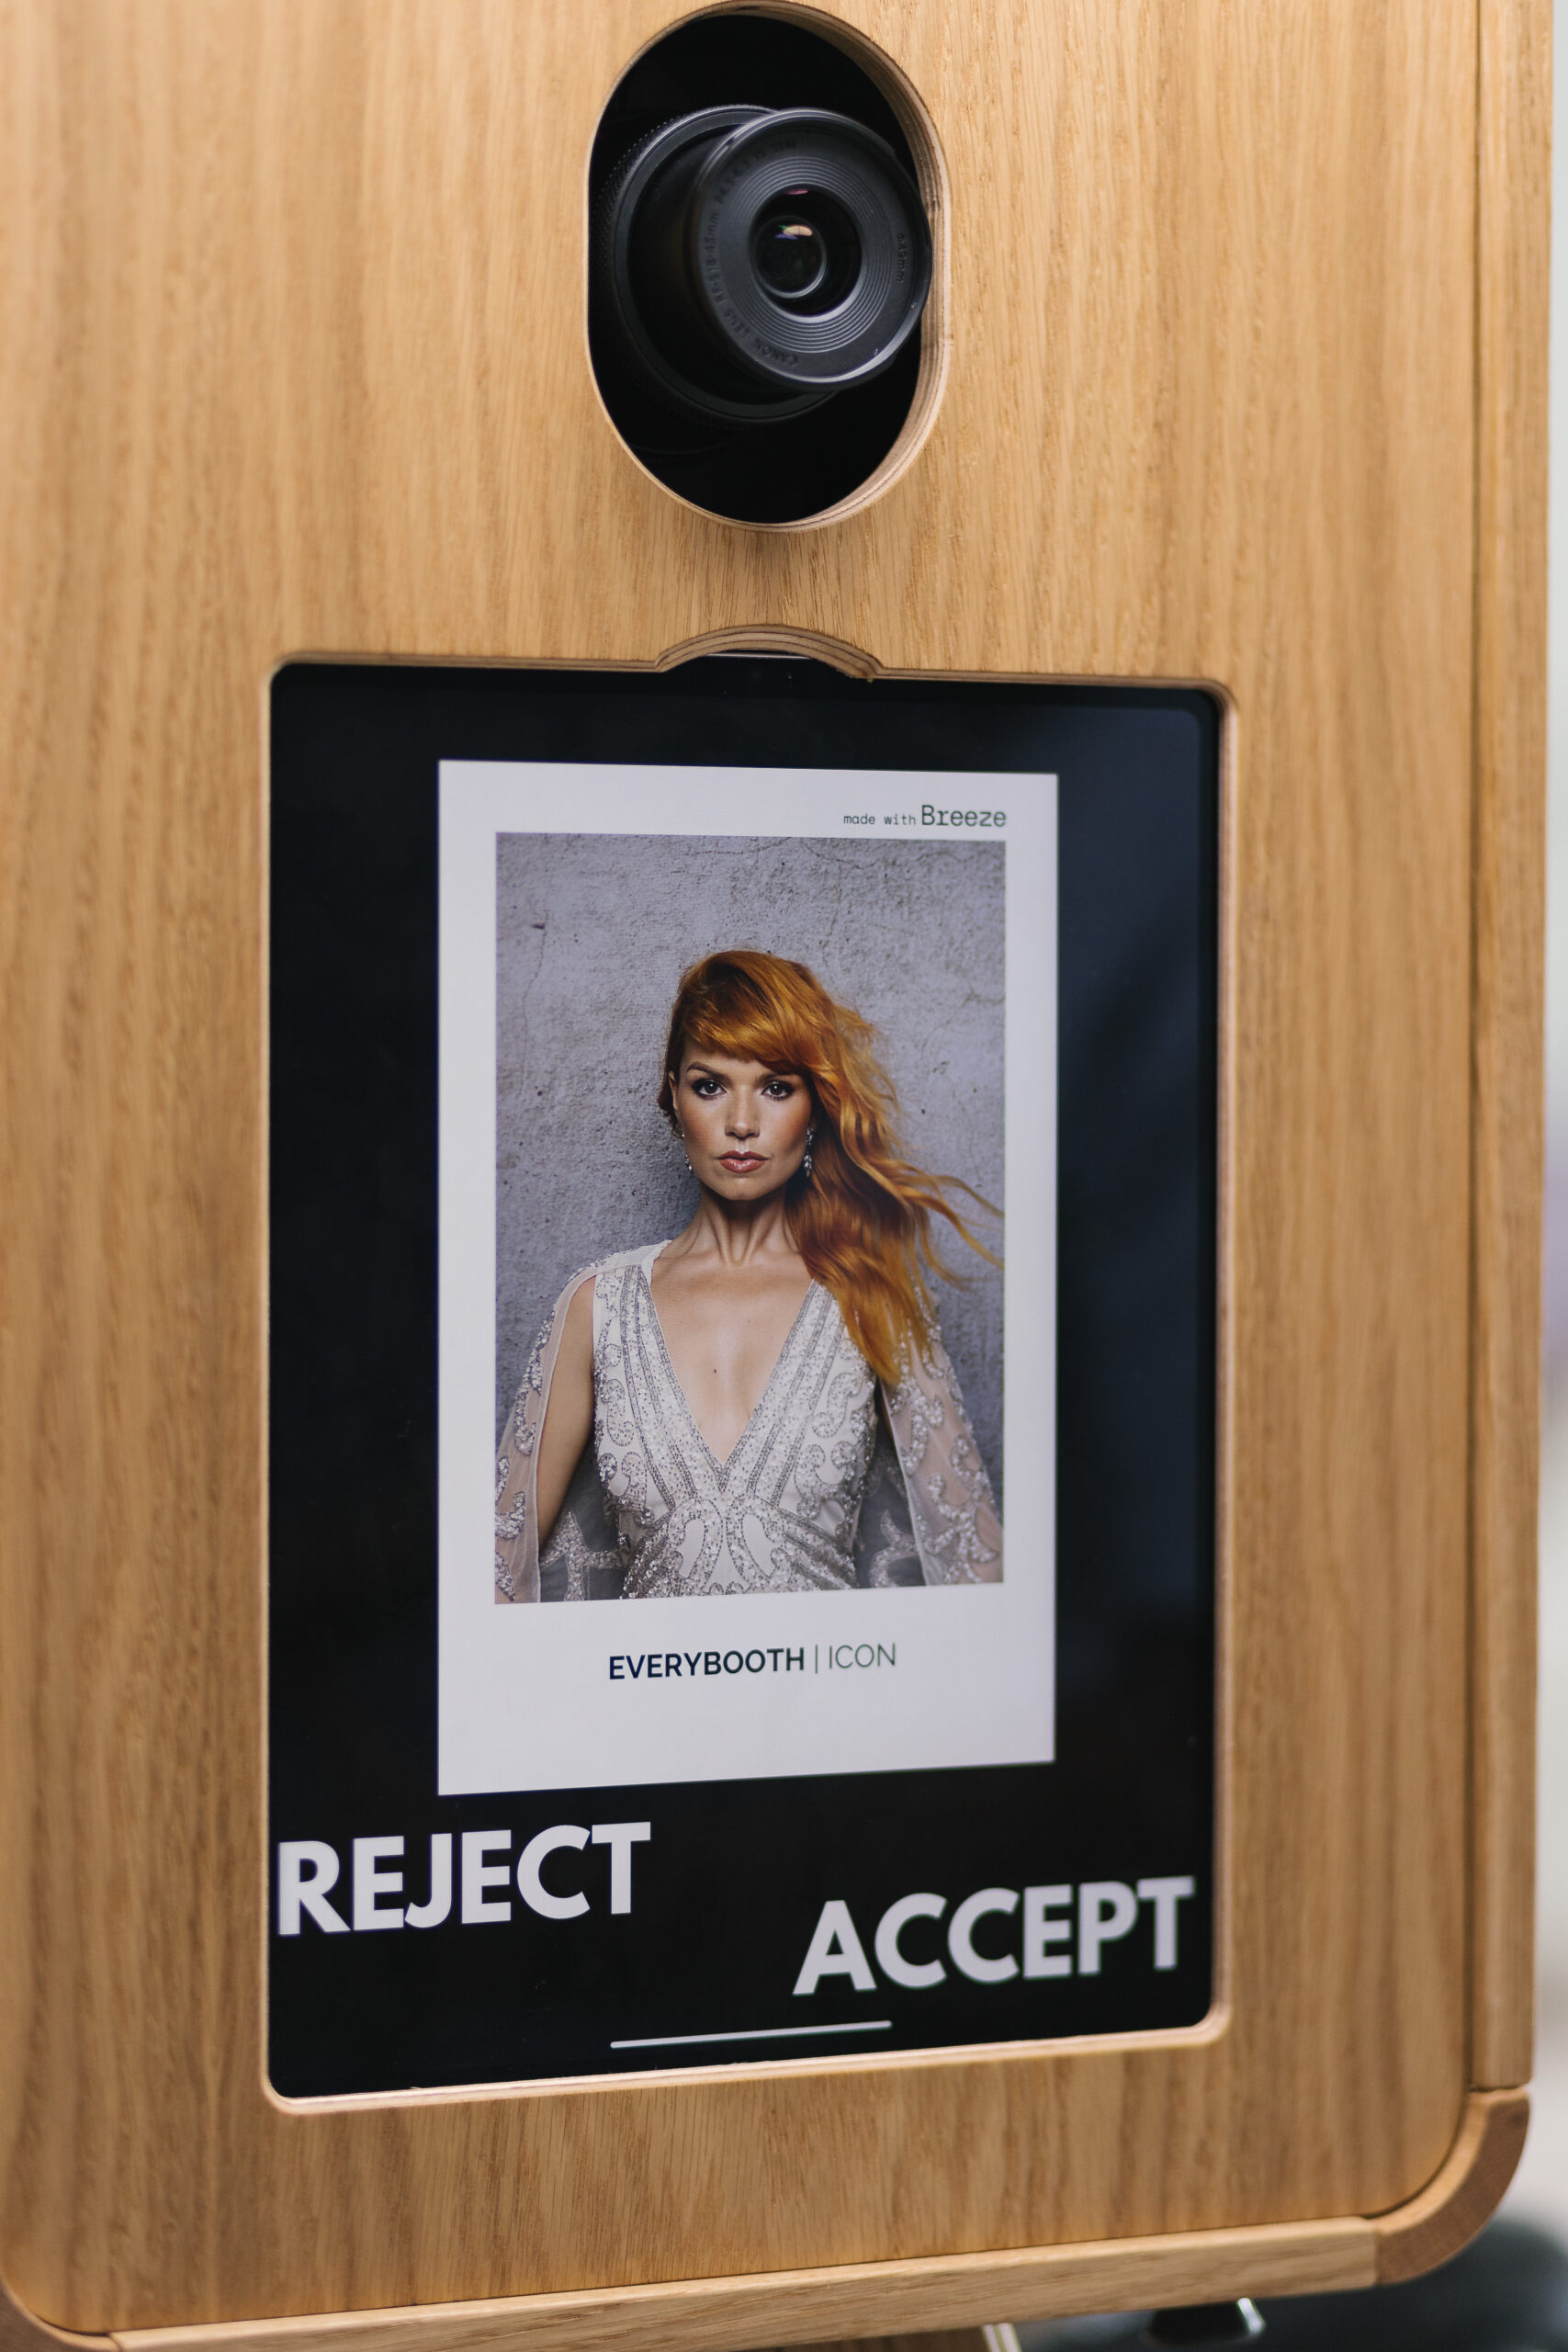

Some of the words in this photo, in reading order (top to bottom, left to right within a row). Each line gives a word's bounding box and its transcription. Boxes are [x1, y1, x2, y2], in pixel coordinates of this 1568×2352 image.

[753, 337, 798, 367] CANON
[842, 813, 875, 825] made
[883, 814, 917, 826] with
[921, 804, 1007, 828] Breeze
[609, 1646, 805, 1680] EVERYBOOTH
[829, 1643, 897, 1669] ICON
[277, 1821, 653, 1936] REJECT
[792, 1878, 1194, 1996] ACCEPT
